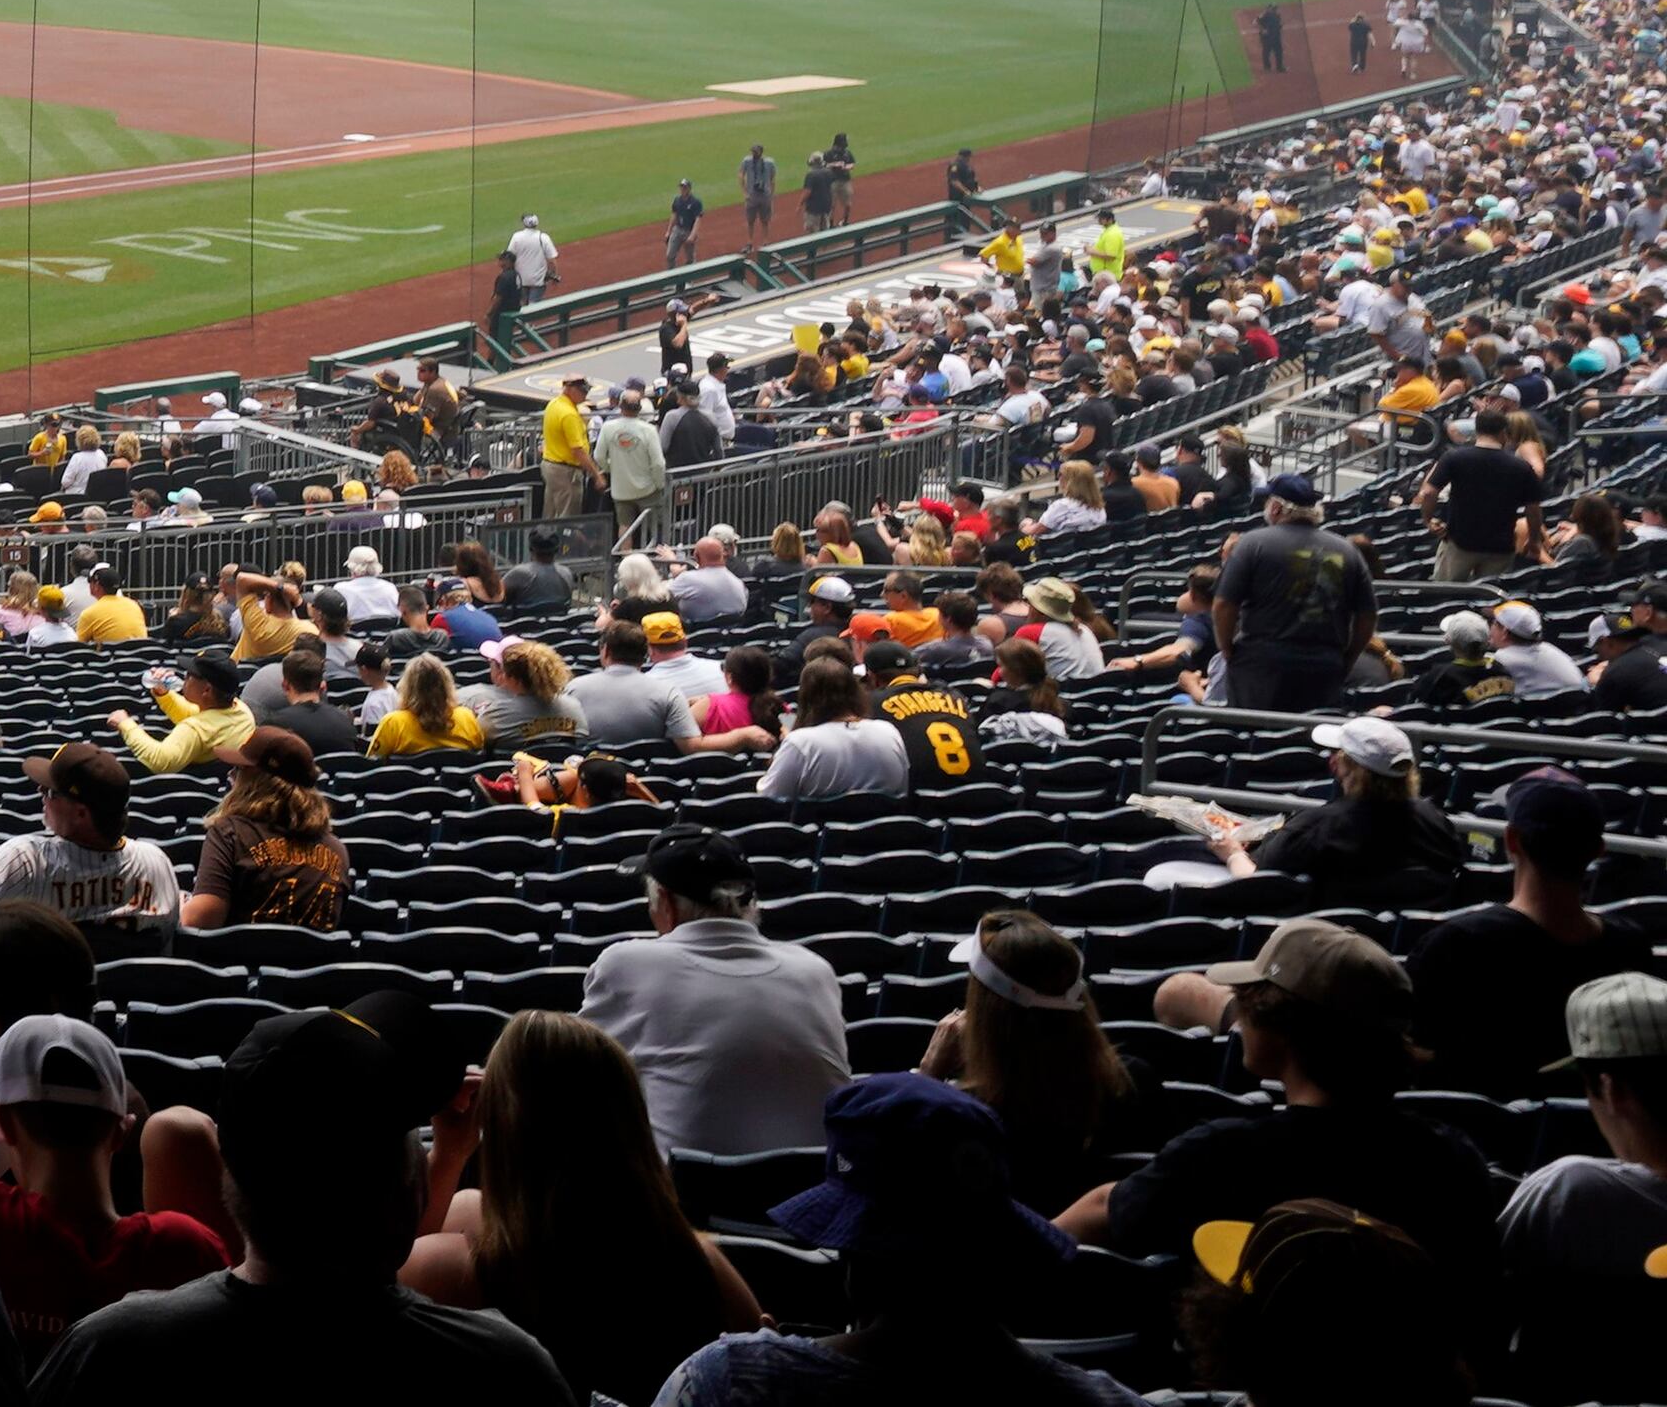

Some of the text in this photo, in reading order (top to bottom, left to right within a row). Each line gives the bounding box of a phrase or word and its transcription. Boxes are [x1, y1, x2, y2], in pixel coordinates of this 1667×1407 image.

[91, 208, 445, 264] PNC
[881, 689, 968, 721] STARGELL
[926, 720, 971, 776] 8
[51, 878, 158, 913] TATIS JR.
